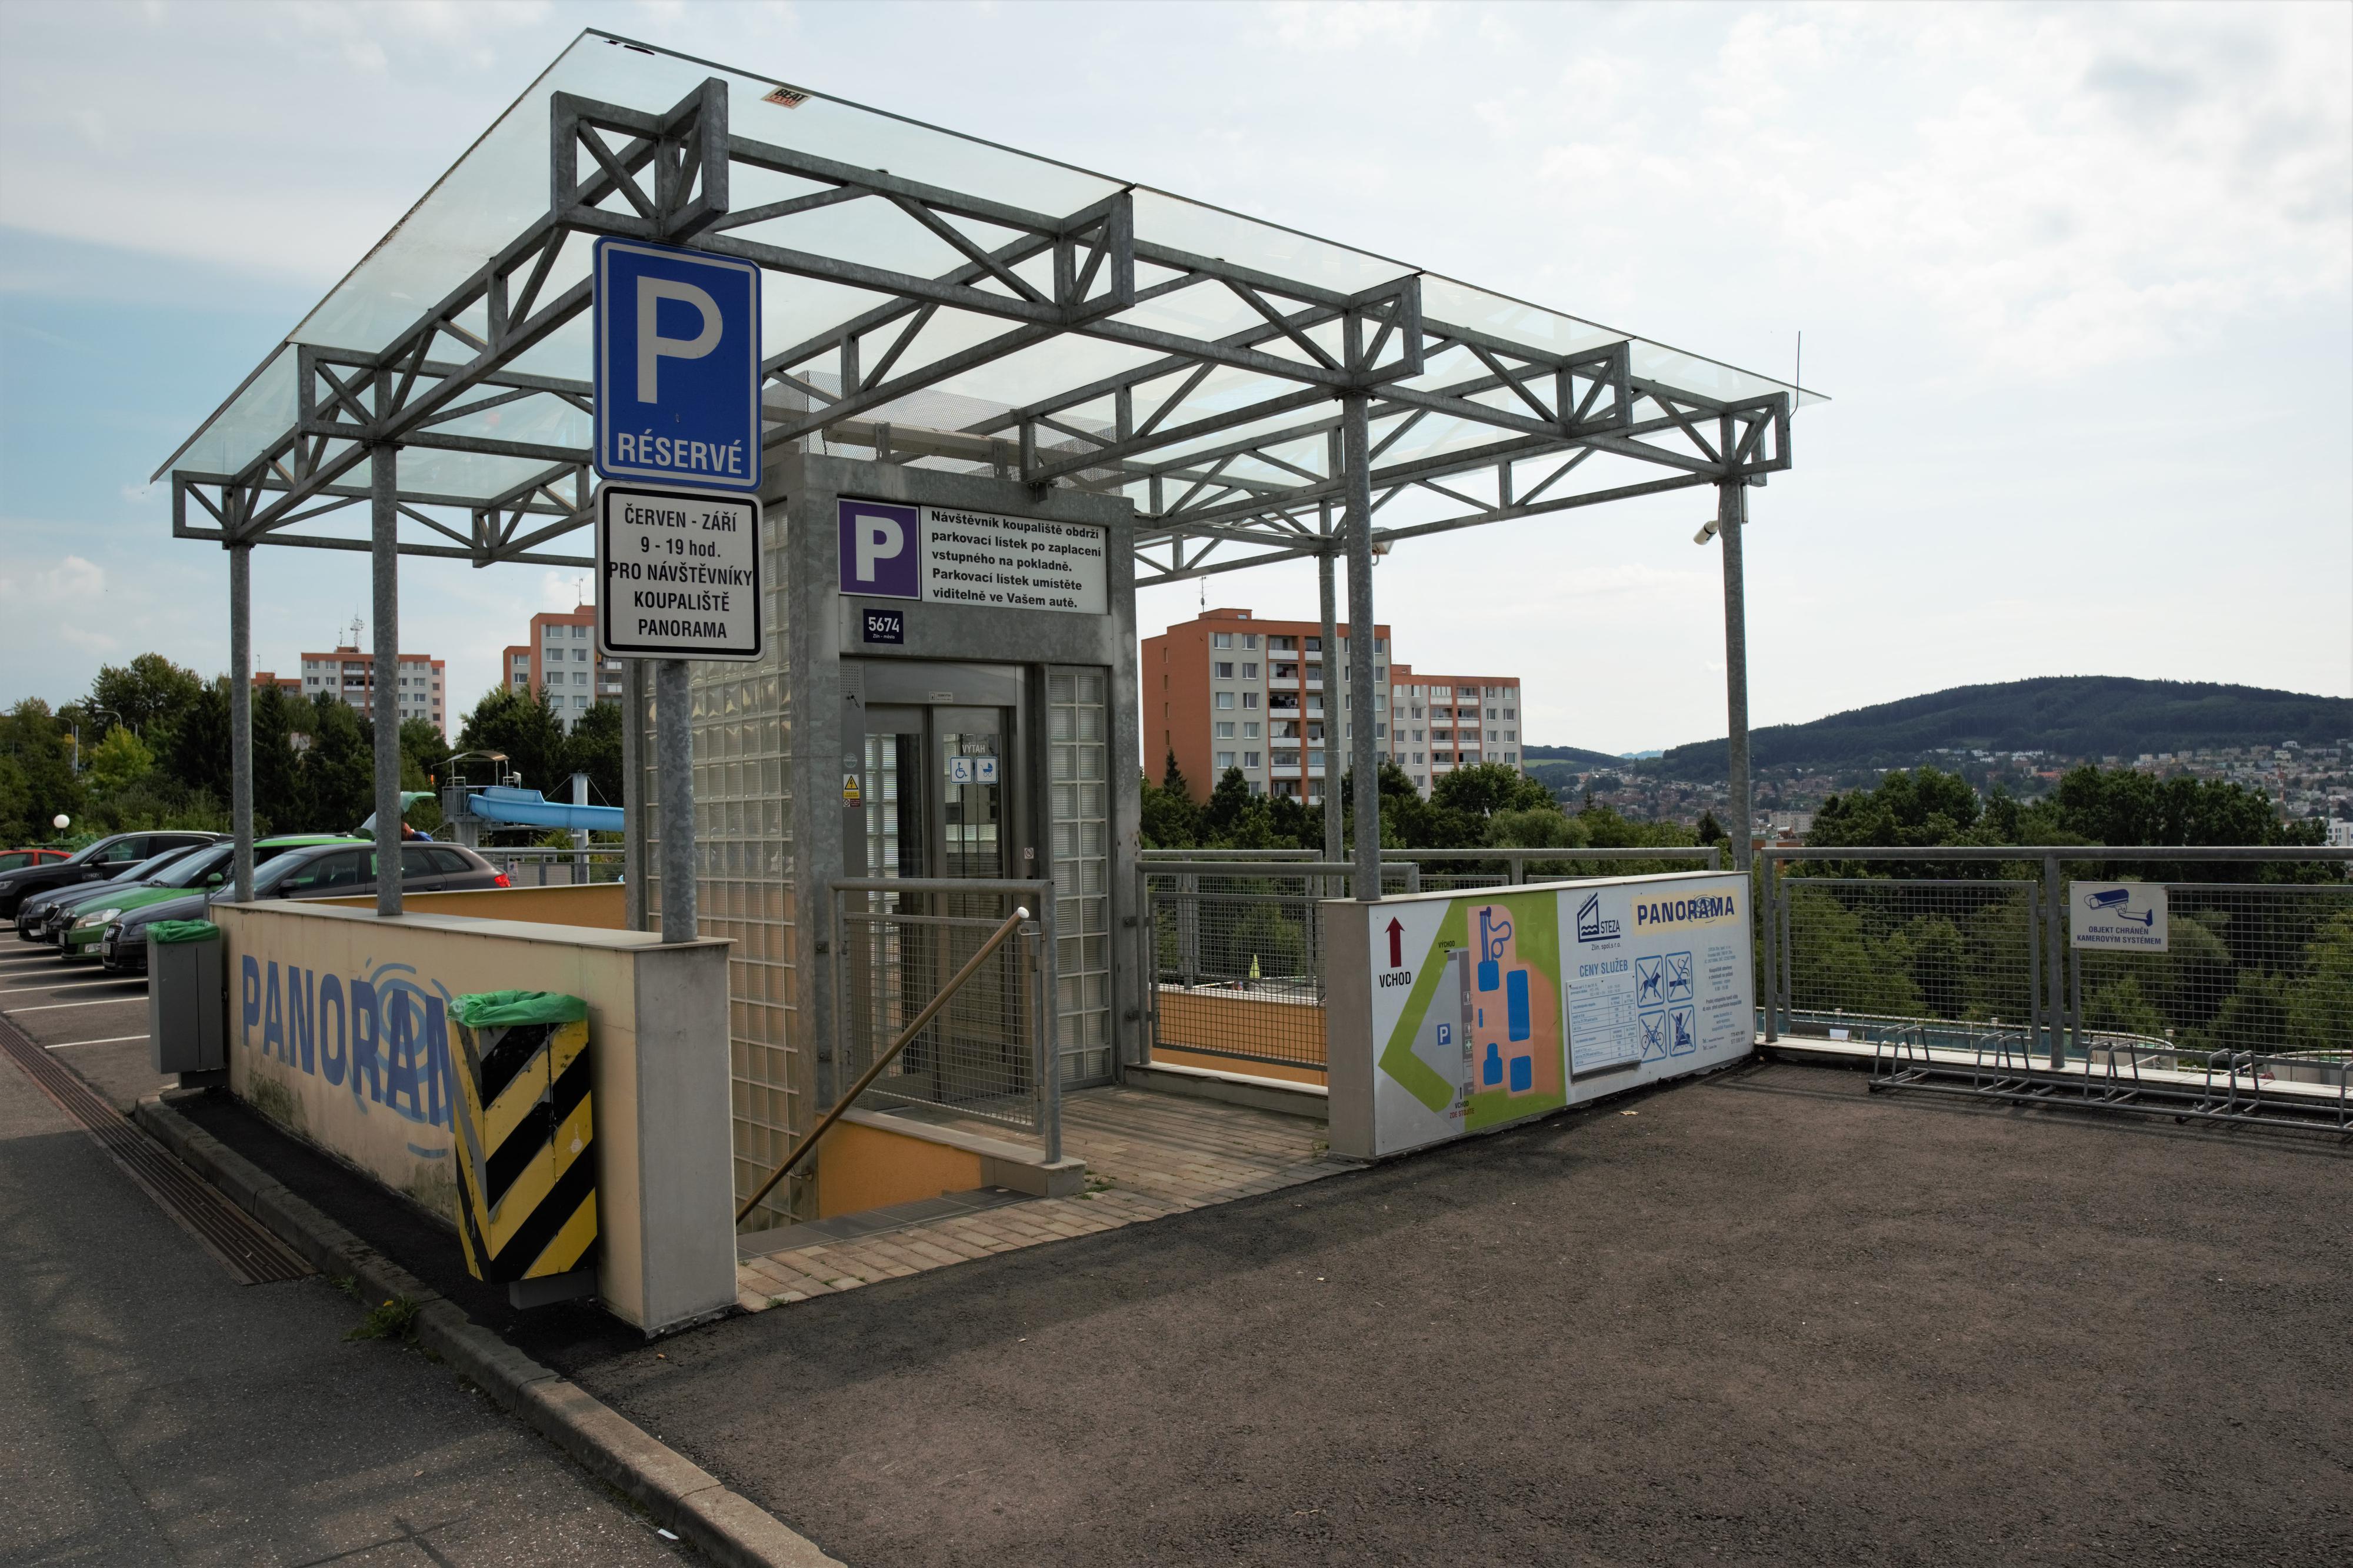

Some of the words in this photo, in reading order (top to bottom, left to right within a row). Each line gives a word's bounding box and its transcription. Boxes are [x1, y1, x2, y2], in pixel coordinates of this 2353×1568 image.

[637, 275, 723, 404] P
[618, 429, 742, 474] RÉSERVÉ
[625, 503, 686, 528] ČERVEN
[702, 511, 737, 532] ZÁŘÍ
[932, 511, 999, 528] Návštěvník
[1003, 519, 1062, 535] koupaliště
[1066, 527, 1099, 539] obdrží
[641, 536, 649, 552] 9
[666, 538, 683, 555] 19
[690, 540, 720, 557] hod.
[855, 514, 904, 582] P
[932, 532, 991, 546] parkovací
[996, 536, 1028, 549] lístek
[1032, 543, 1045, 552] po
[1049, 544, 1101, 557] zaplacení
[932, 550, 995, 564] vstupného
[999, 558, 1013, 566] na
[1017, 558, 1072, 571] pokladně.
[609, 561, 641, 580] PRO
[648, 561, 752, 586] NÁVŠTĚVNÍKY
[933, 568, 992, 583] Parkovací
[997, 573, 1029, 586] lístek
[1033, 578, 1082, 590] umístěte
[635, 590, 730, 611] KOUPALIŠTĚ
[933, 588, 985, 601] viditelně
[1007, 593, 1045, 605] Vašem
[1049, 598, 1077, 608] autě.
[638, 619, 727, 638] PANORAMA
[869, 617, 899, 632] 5674
[962, 743, 985, 753] VÝTAH
[1637, 896, 1735, 925] PANORAMA
[1601, 920, 1620, 934] STEZA
[2116, 926, 2149, 935] CHRÁNĚN
[2077, 934, 2120, 943] KAMEROVÝM
[2122, 936, 2161, 944] SYSTÉMEM
[1579, 964, 1598, 977] CENY
[1601, 958, 1628, 974] SLUŽEB
[1379, 971, 1411, 988] VCHOD
[1440, 1026, 1448, 1043] P
[1458, 1107, 1474, 1116] STOJÍTE
